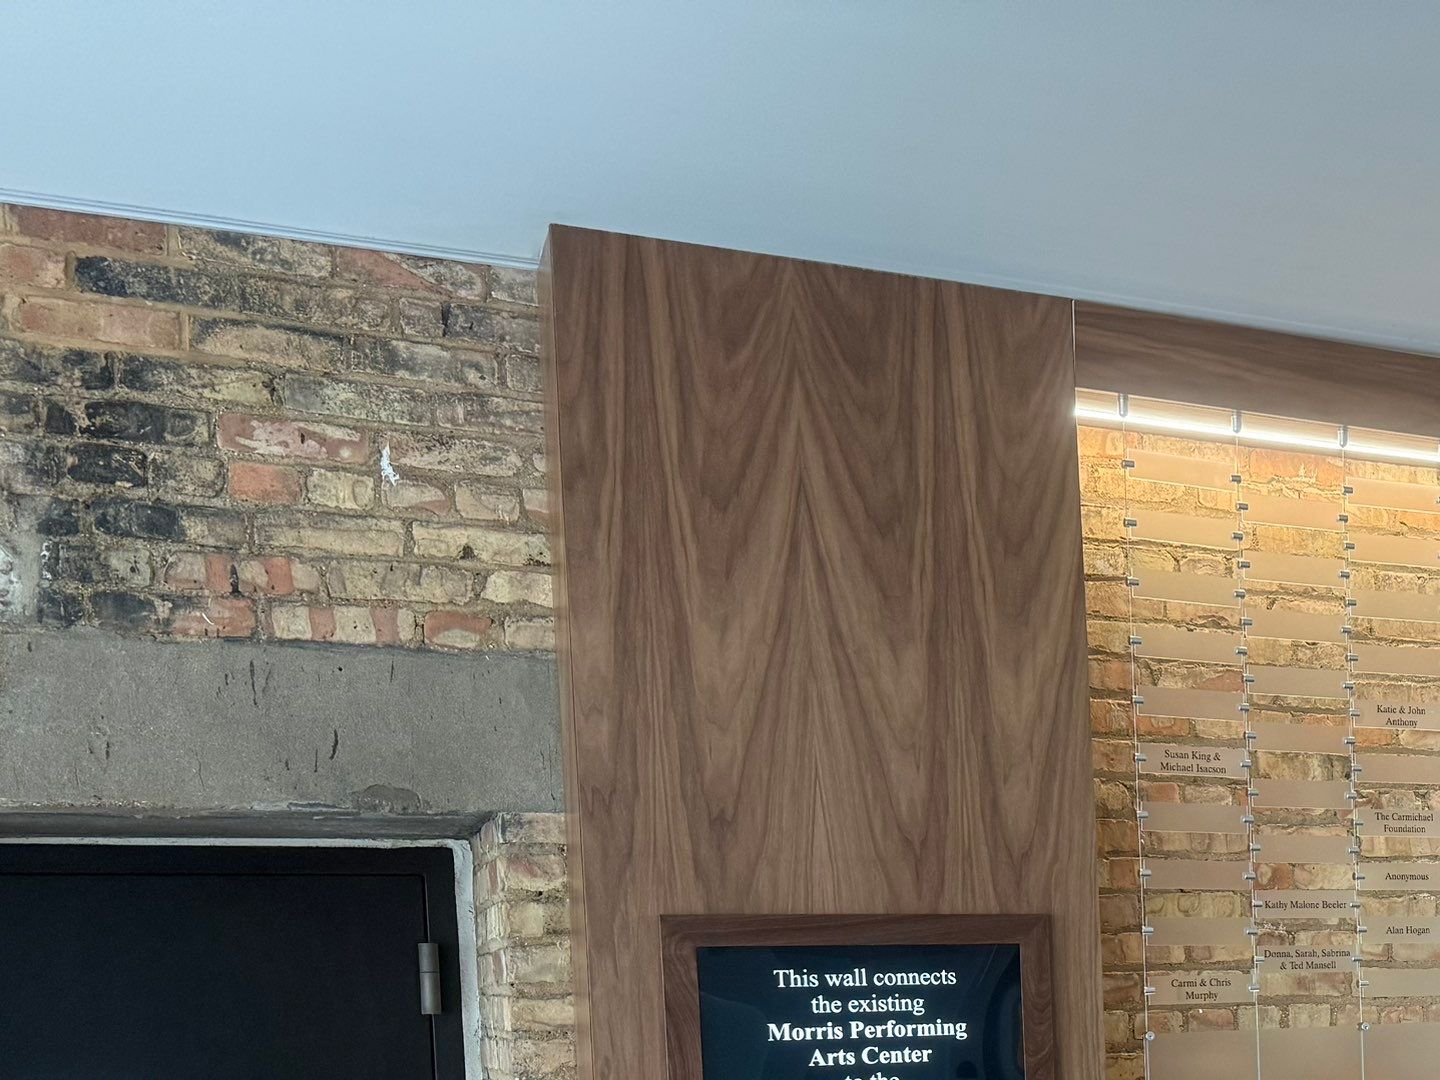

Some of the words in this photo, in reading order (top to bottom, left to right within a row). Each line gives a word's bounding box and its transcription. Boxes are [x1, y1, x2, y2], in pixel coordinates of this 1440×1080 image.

[1377, 704, 1398, 715] Katie
[1400, 706, 1406, 715] &
[1408, 706, 1426, 716] John
[1386, 717, 1418, 728] Anthony
[1165, 749, 1189, 759] Susan
[1192, 751, 1211, 762] King
[1213, 753, 1221, 761] &
[1160, 762, 1193, 771] Michael
[1374, 811, 1389, 822] The
[1391, 812, 1434, 822] Carmichael
[1383, 823, 1426, 834] Foundation
[1385, 872, 1429, 882] Anonymous
[1265, 901, 1288, 910] Kathy
[1386, 925, 1403, 935] Alan
[1405, 925, 1430, 937] Hogan
[1264, 950, 1293, 958] Donna,
[1295, 949, 1320, 957] Sarah,
[1322, 949, 1351, 957] Sabrina
[1280, 962, 1287, 970] &
[1306, 961, 1336, 969] Mansell
[774, 969, 819, 989] This
[825, 968, 867, 987] wall
[874, 968, 957, 986] connects
[1171, 977, 1196, 988] Carmi
[1198, 978, 1206, 988] &
[1208, 977, 1232, 987] Chris
[1185, 989, 1218, 1002] Murphy
[811, 996, 842, 1014] the
[848, 994, 925, 1015] existing
[768, 1021, 843, 1042] Morris
[850, 1019, 967, 1040] Performing
[809, 1048, 855, 1067] Arts
[861, 1046, 932, 1065] Center
